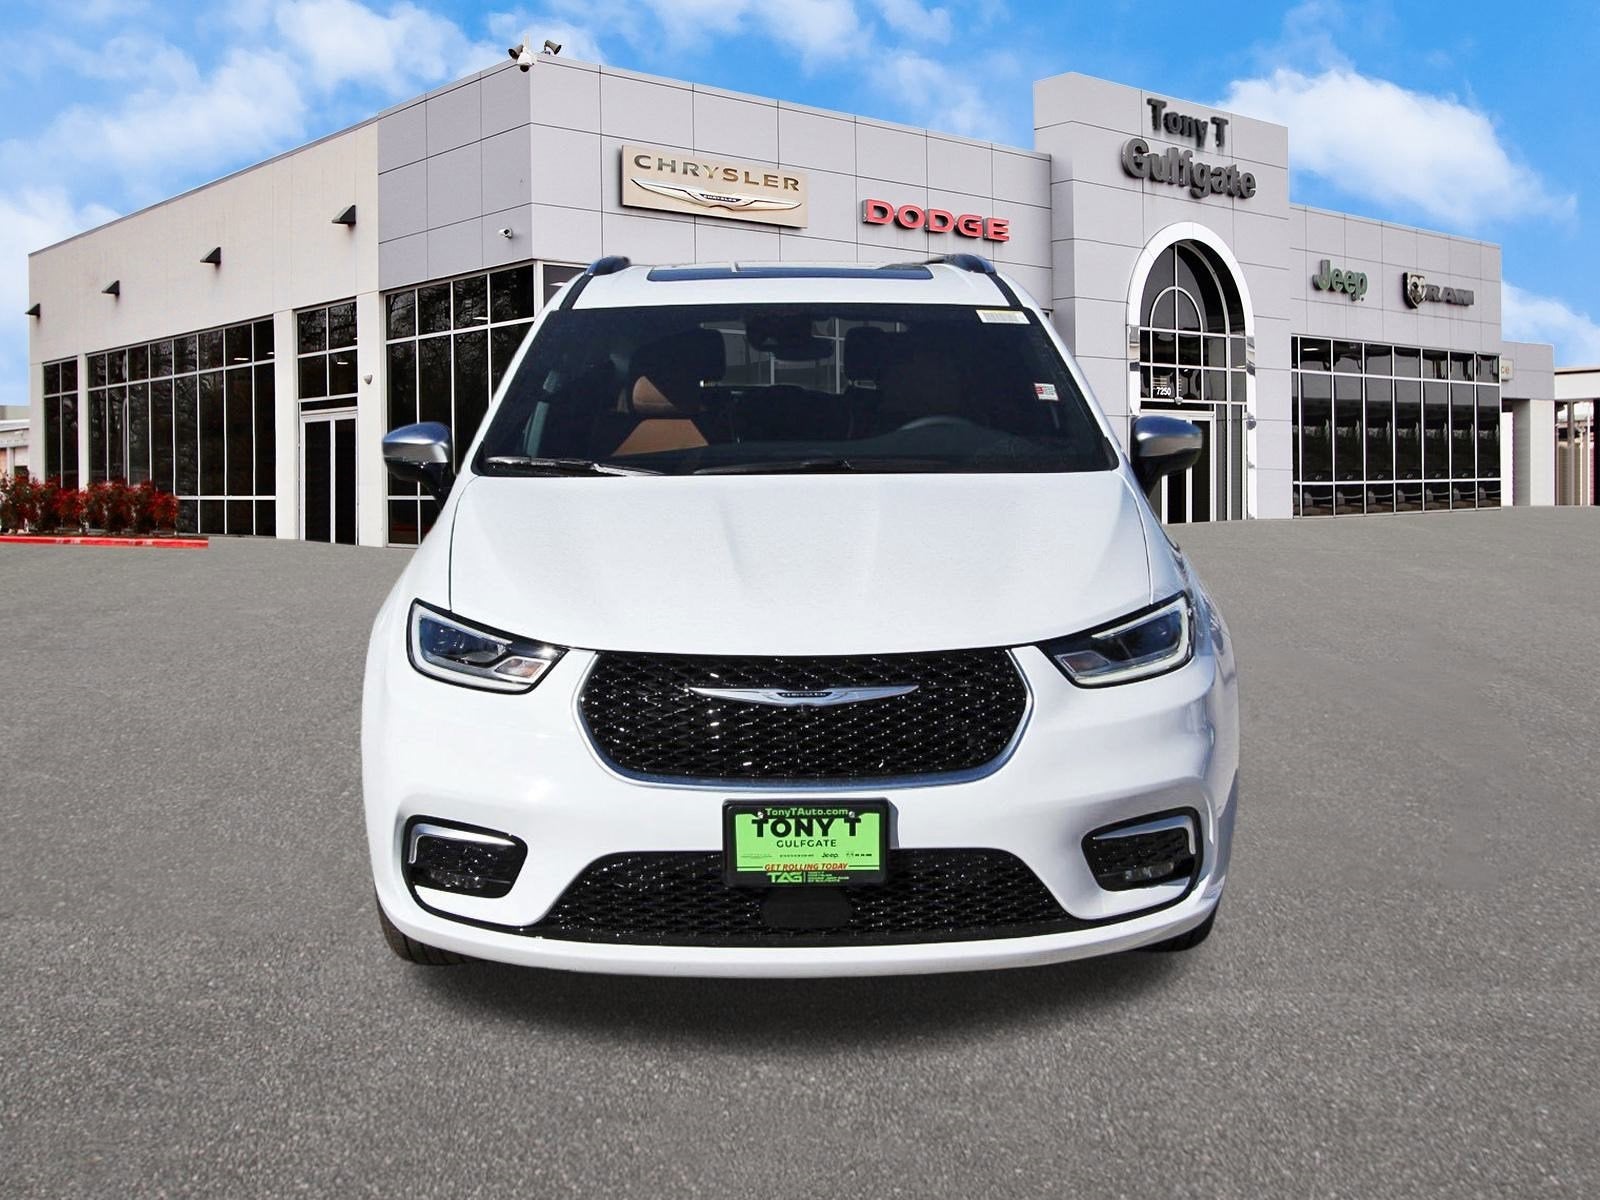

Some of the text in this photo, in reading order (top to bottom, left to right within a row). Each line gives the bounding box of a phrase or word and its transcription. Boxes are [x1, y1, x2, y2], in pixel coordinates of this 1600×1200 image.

[1147, 98, 1229, 148] Tony T
[634, 155, 799, 191] CHRYSLER
[1121, 138, 1257, 199] Gulfgate
[862, 199, 1010, 242] DODGE
[1312, 259, 1368, 302] Jeep
[1425, 284, 1474, 306] RAM
[765, 807, 849, 817] TonyTAuto.com
[751, 817, 862, 838] TONY T
[776, 839, 837, 848] GULFGATE
[764, 862, 848, 871] GET ROLLING TODAY
[767, 872, 803, 883] TAG
